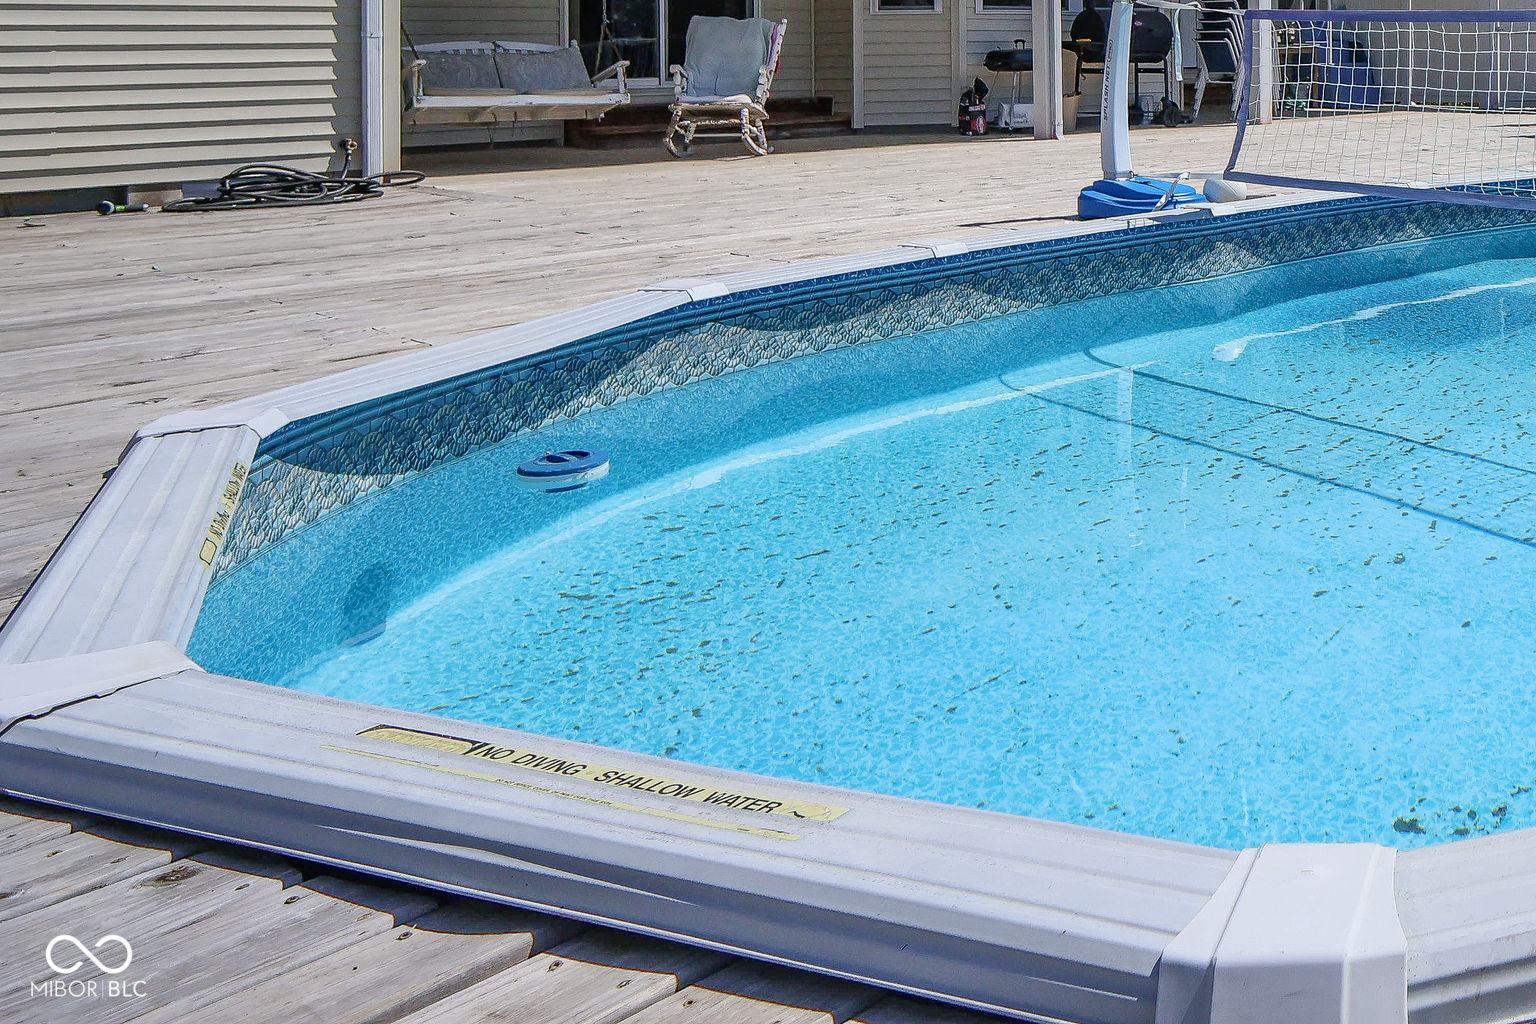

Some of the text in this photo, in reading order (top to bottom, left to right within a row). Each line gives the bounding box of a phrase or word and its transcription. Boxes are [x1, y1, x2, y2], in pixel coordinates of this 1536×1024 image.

[474, 746, 515, 759] NO
[511, 754, 587, 775] DIVING
[594, 771, 705, 798] SHALLOW
[703, 791, 783, 813] WATER
